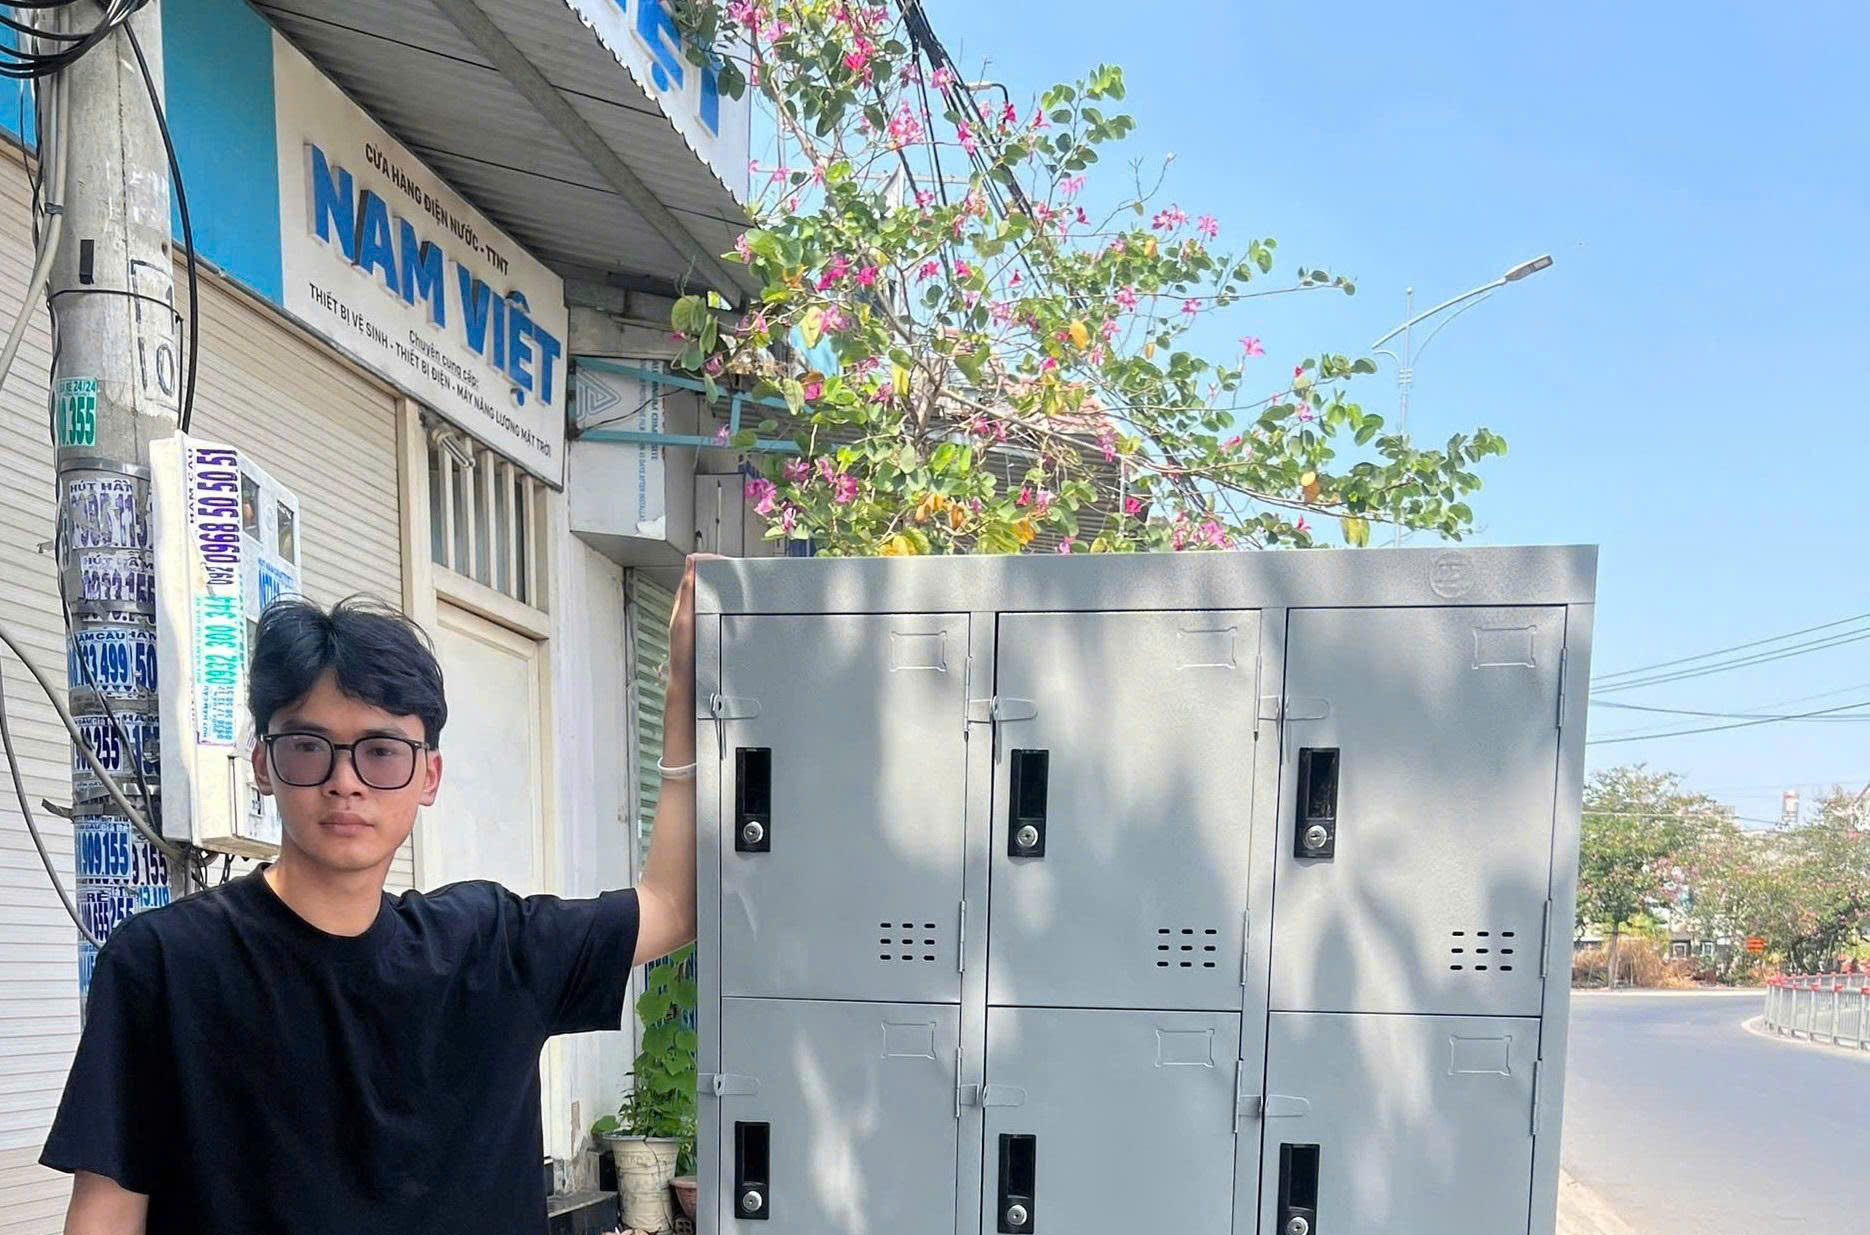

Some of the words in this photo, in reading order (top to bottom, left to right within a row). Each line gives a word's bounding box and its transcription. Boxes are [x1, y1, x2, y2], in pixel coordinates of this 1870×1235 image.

[365, 142, 390, 179] CỬA
[391, 164, 422, 205] HÀNG
[423, 193, 449, 228] ĐIỆN
[449, 216, 479, 252] NƯỚC
[485, 244, 509, 276] TTNT
[304, 143, 446, 330] NAM
[450, 260, 561, 407] VIỆT
[309, 282, 338, 314] THIẾT
[339, 303, 351, 326] BỊ
[352, 311, 364, 334] VỆ
[365, 321, 389, 349] SINH
[395, 341, 420, 369] THIẾT
[421, 360, 430, 379] BỊ
[431, 368, 450, 390] ĐIỆN
[409, 330, 440, 362] Chuyên
[441, 354, 462, 380] cung
